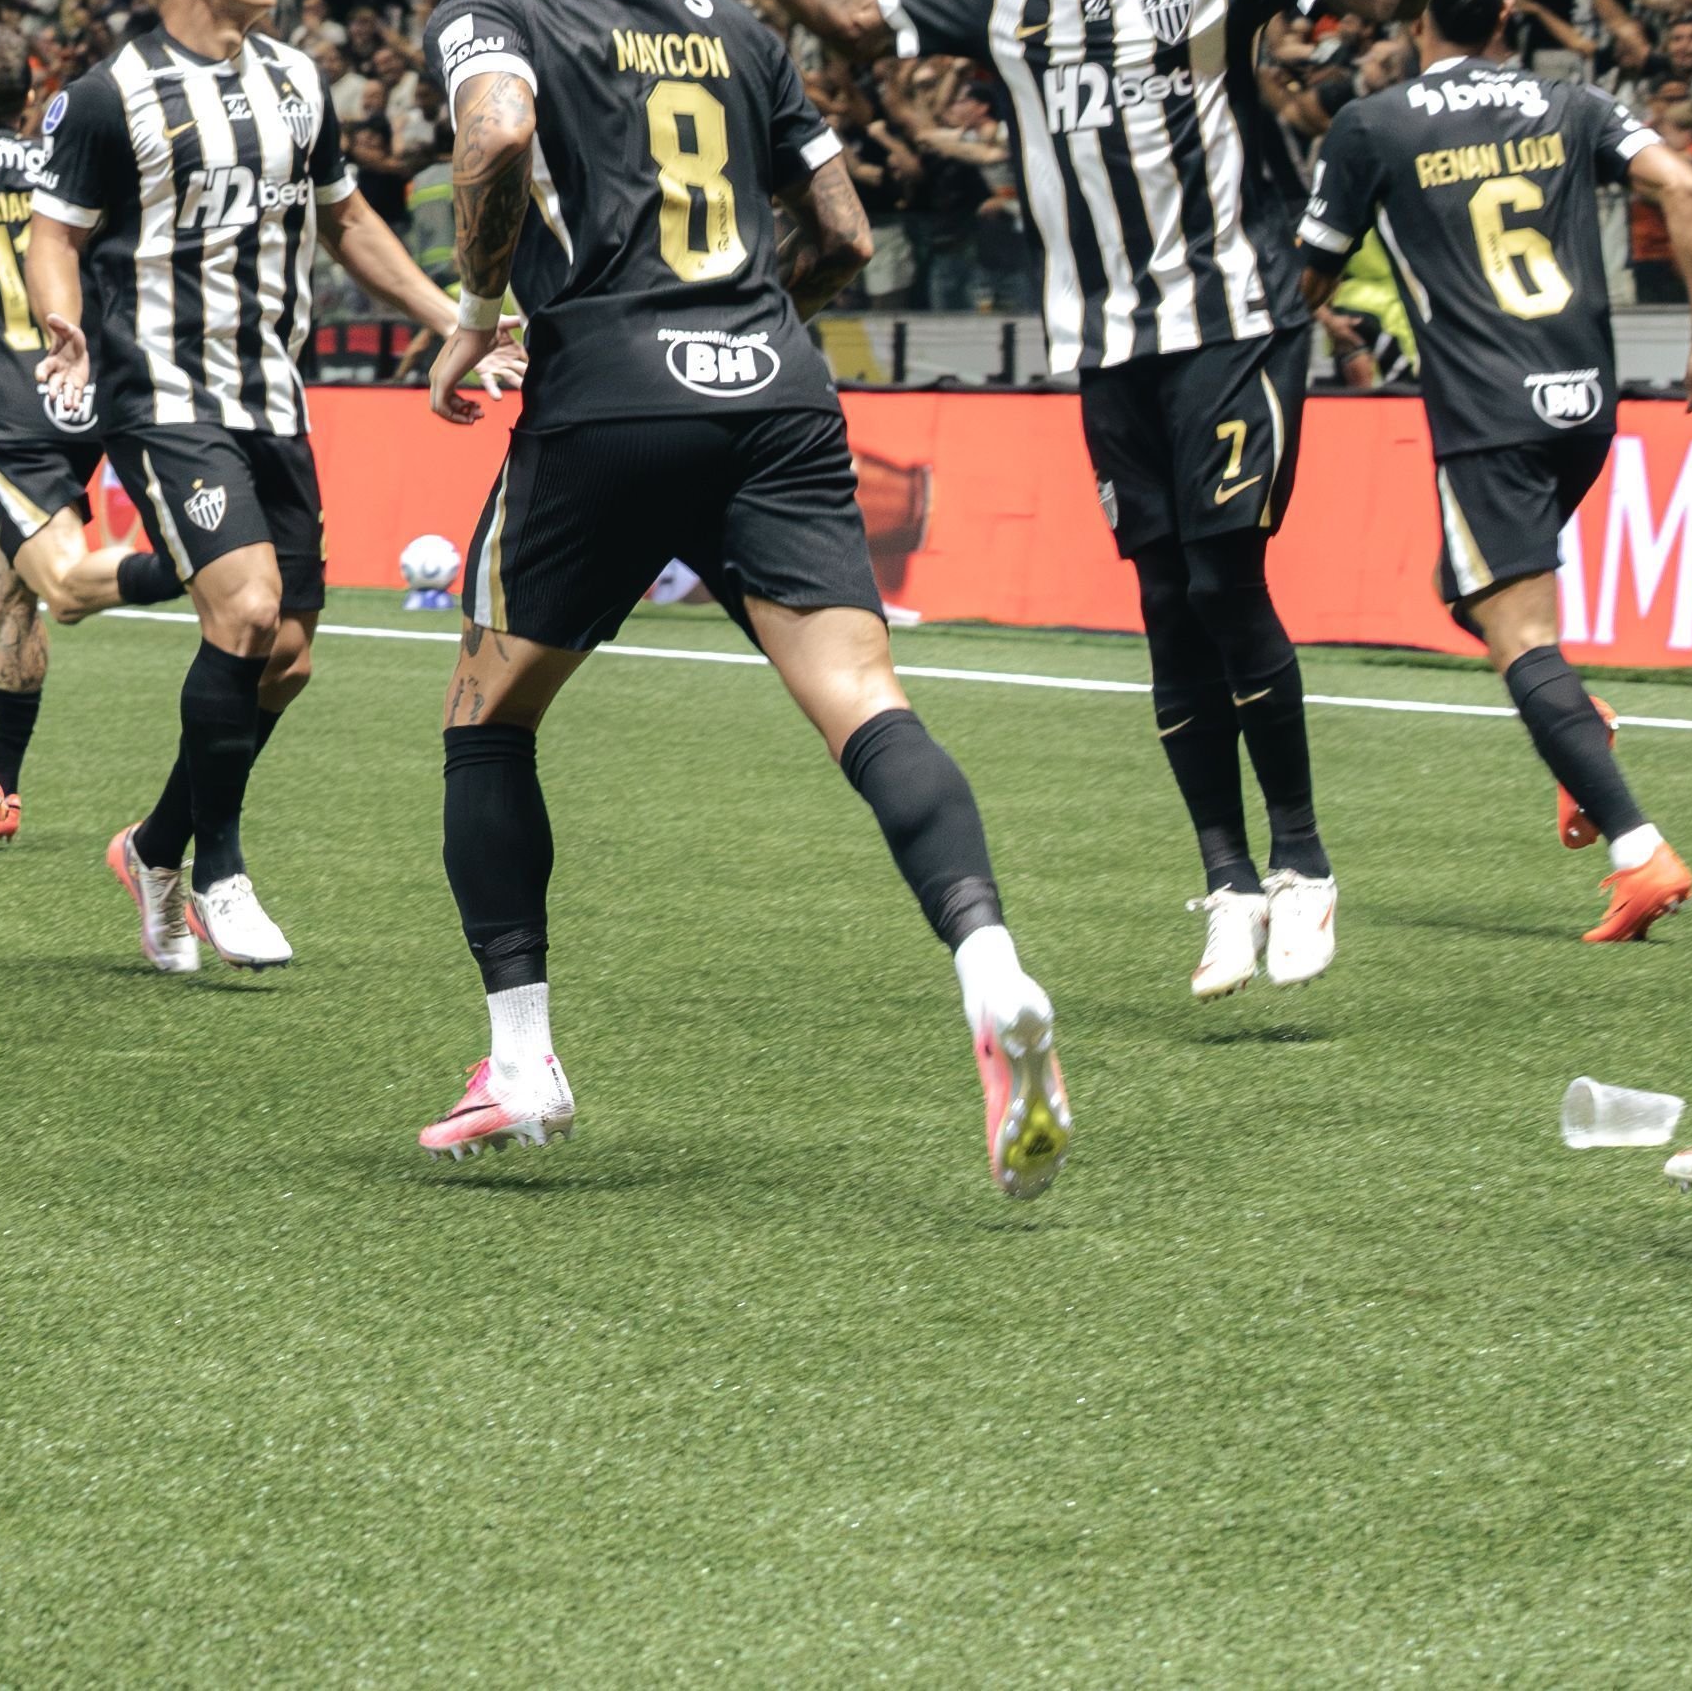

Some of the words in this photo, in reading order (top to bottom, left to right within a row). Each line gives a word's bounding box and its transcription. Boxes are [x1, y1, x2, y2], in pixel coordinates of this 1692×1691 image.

[612, 28, 731, 79] MAYCON
[1112, 66, 1194, 108] bet
[1440, 79, 1550, 117] bmg
[1503, 131, 1566, 174] LODI
[645, 80, 749, 283] 8
[1468, 174, 1574, 320] 6
[686, 342, 758, 383] BH
[1216, 420, 1247, 479] 7
